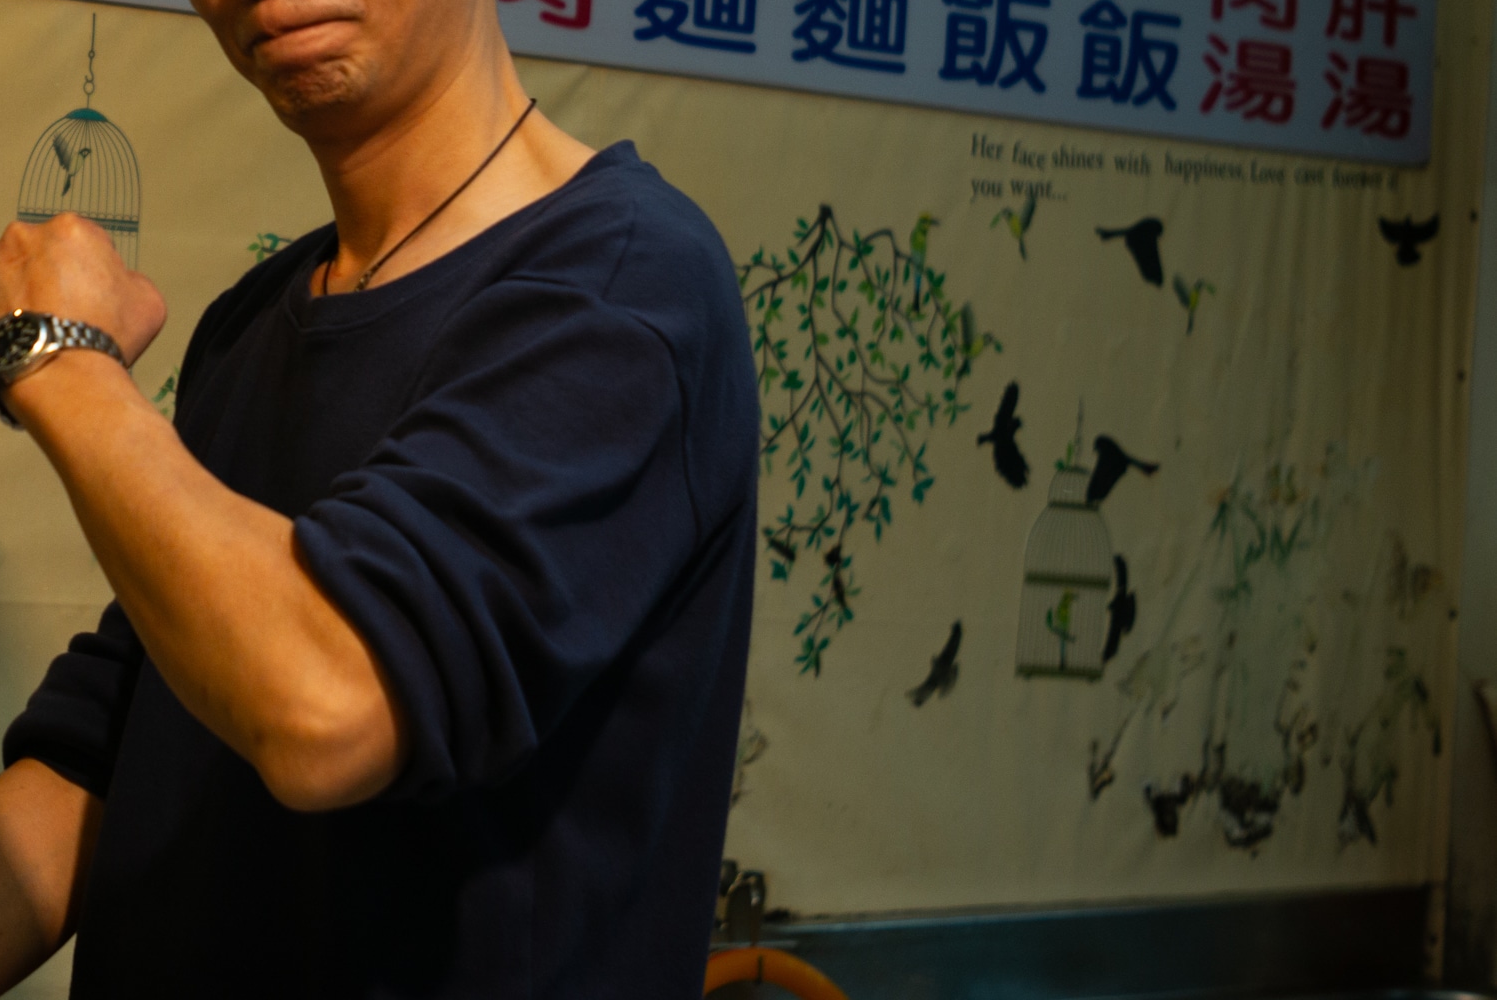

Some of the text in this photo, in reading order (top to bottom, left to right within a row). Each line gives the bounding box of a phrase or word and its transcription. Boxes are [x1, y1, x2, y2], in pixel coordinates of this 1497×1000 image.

[971, 132, 1003, 161] Her
[1012, 140, 1046, 170] face
[1051, 142, 1104, 170] shines
[1113, 150, 1151, 176] with
[971, 178, 1003, 203] you
